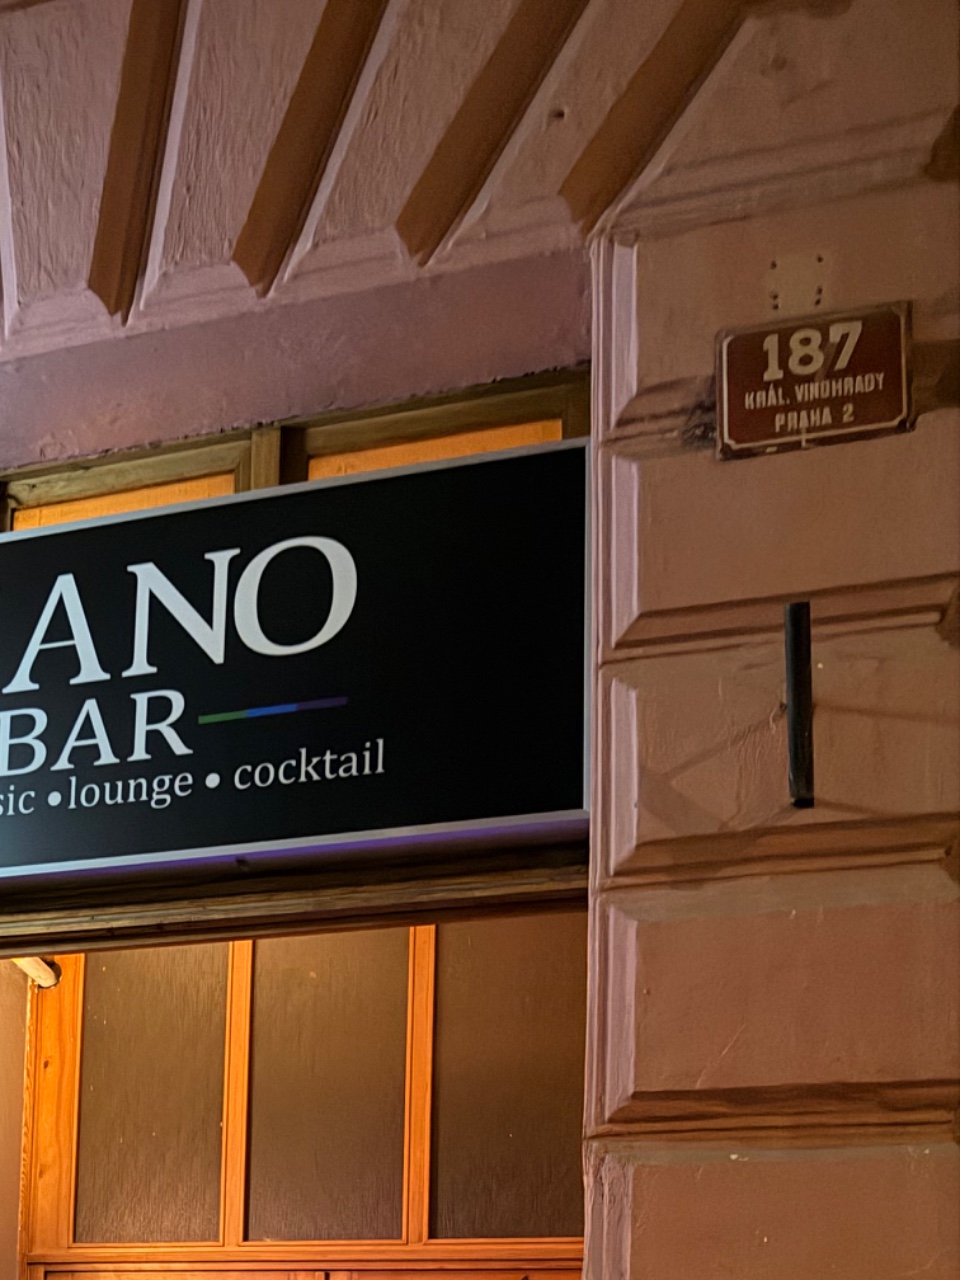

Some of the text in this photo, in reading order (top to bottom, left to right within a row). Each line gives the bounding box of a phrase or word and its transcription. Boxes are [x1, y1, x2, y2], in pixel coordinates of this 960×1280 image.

[762, 320, 863, 382] 187
[745, 372, 885, 410] KRÁL. VINOHRADY
[775, 403, 854, 433] PRAHA 2
[68, 776, 194, 809] lounge
[234, 738, 385, 790] cocktail
